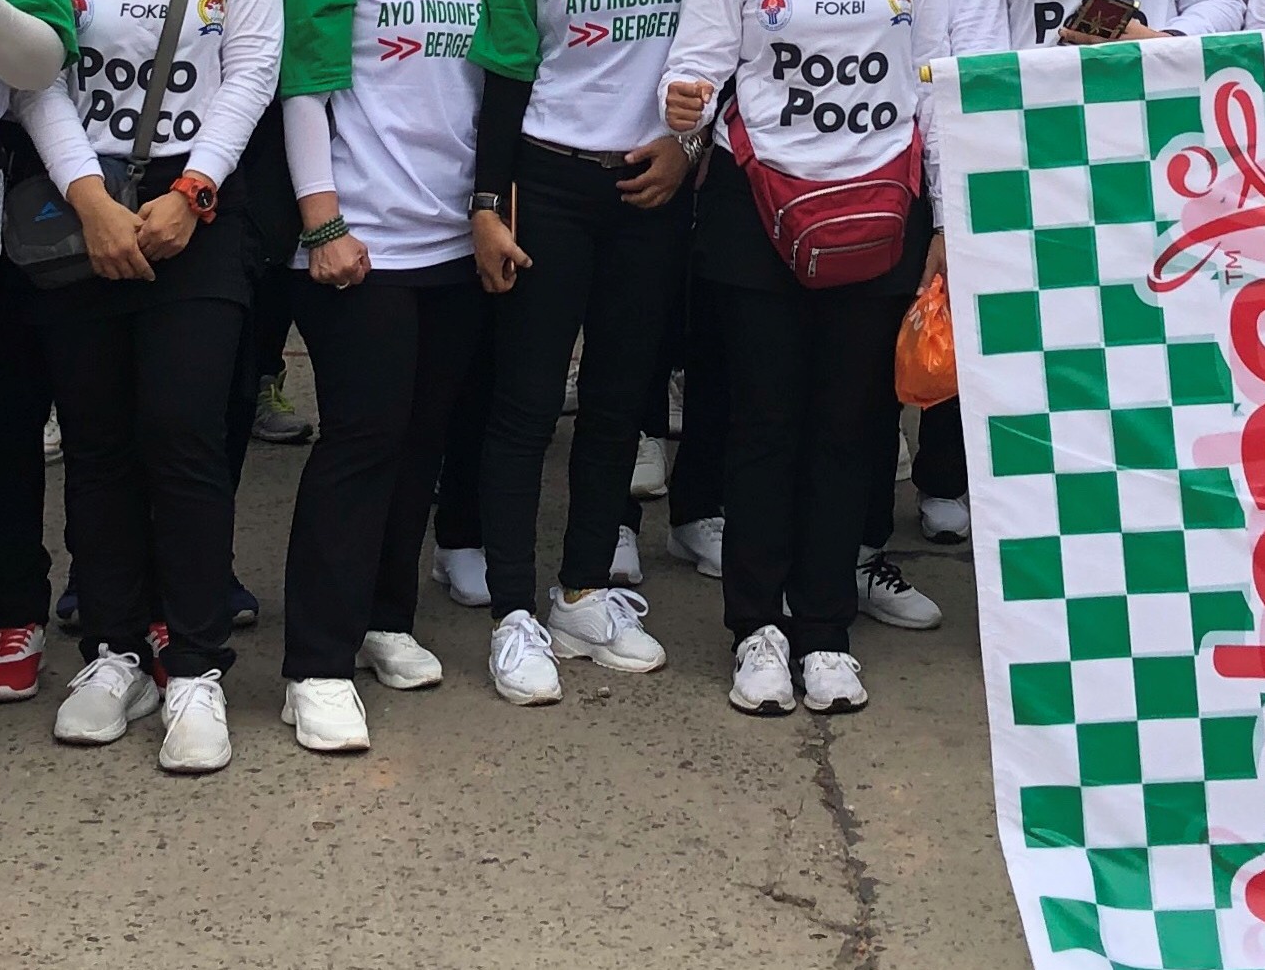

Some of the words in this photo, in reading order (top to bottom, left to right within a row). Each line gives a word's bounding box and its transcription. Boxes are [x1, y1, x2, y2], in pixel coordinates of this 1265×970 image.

[377, 0, 415, 28] AYO
[815, 0, 866, 15] FOKBI
[771, 42, 889, 87] Poco
[780, 87, 898, 134] Poco
